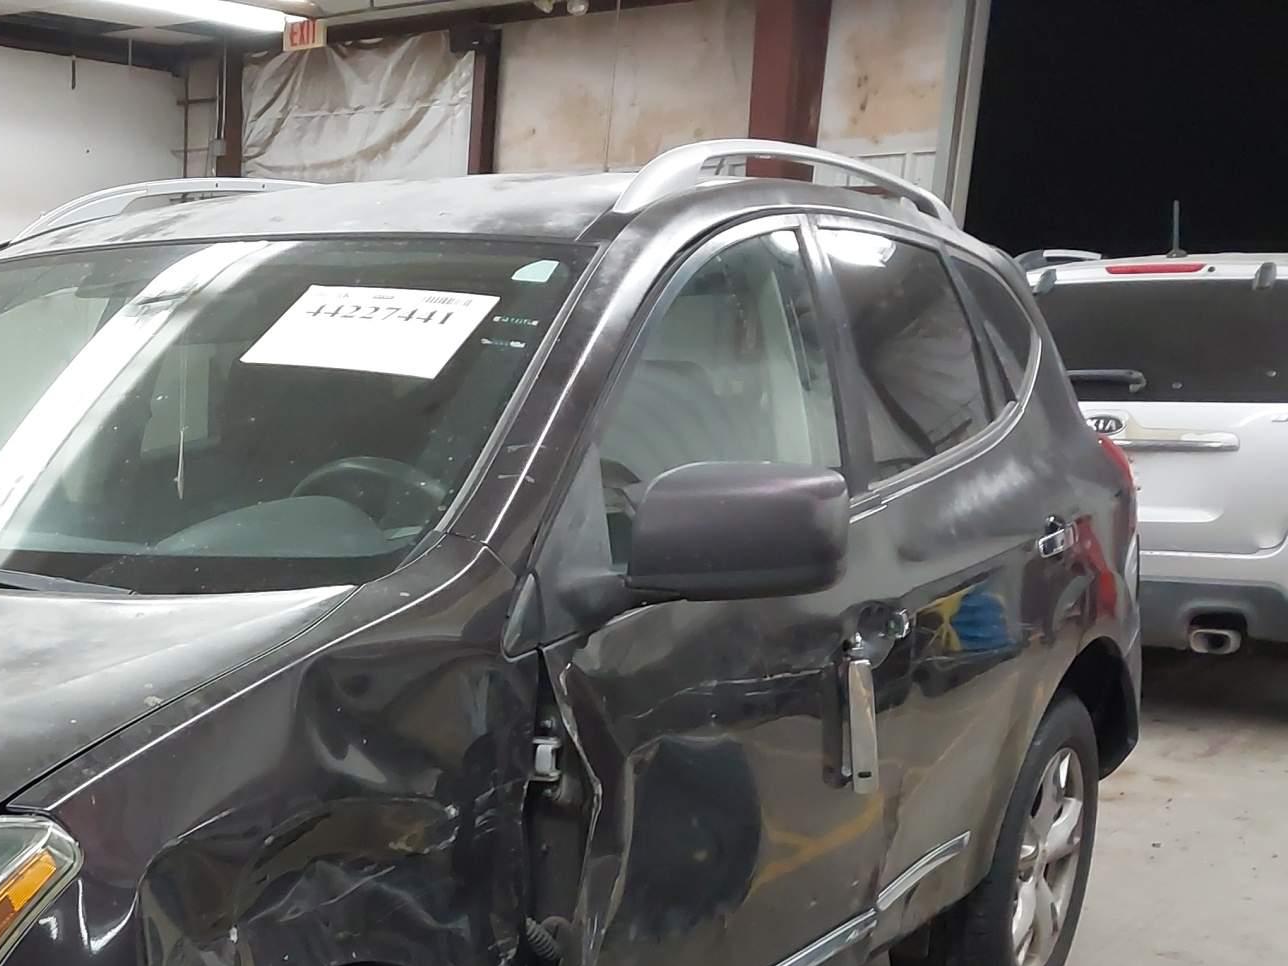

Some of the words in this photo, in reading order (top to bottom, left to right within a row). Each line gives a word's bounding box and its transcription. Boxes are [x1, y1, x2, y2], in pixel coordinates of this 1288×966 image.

[289, 20, 318, 47] EXIT
[305, 303, 455, 326] 44227441
[1086, 418, 1117, 431] KIA
